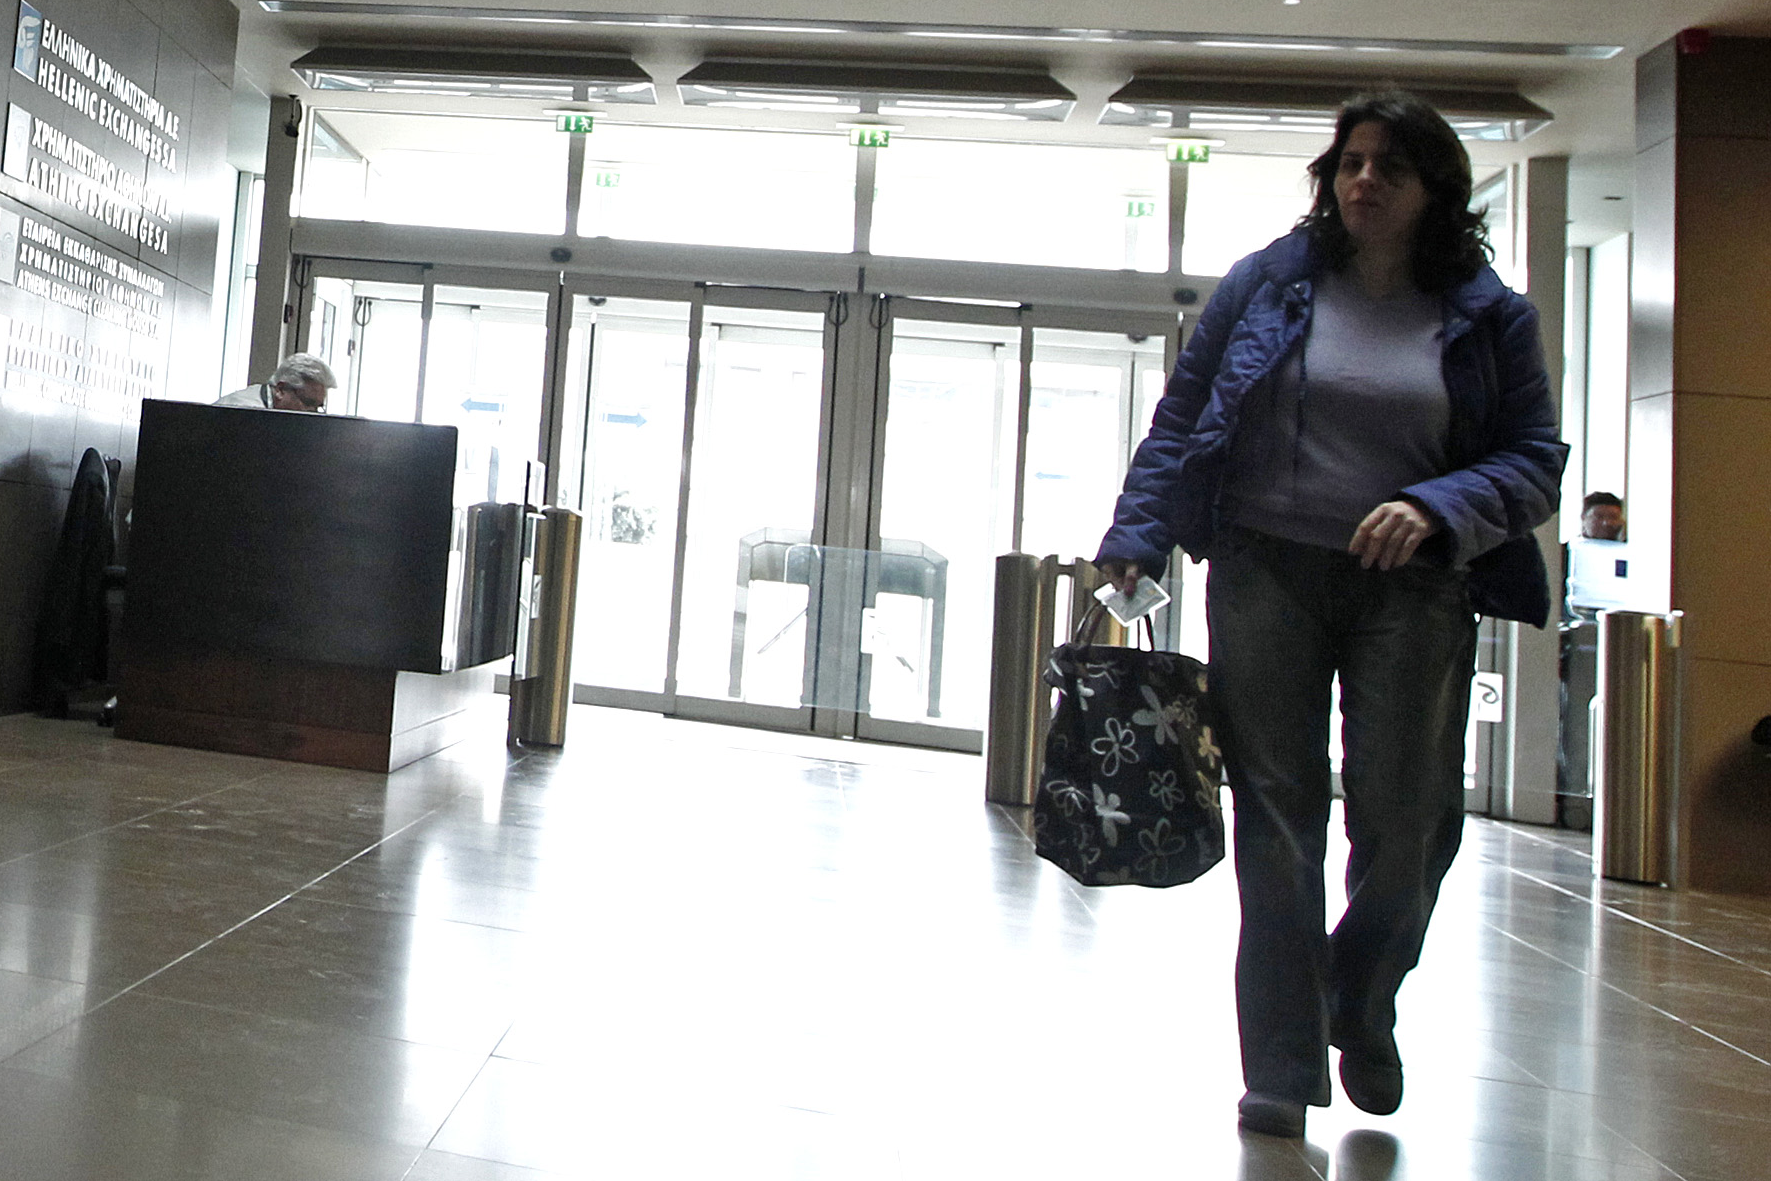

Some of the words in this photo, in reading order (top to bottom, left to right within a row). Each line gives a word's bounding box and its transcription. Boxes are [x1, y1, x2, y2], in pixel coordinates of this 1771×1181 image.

[41, 18, 96, 82] ΕΛΛΗΝΙΚΑ
[37, 57, 98, 121] HELLENIC
[98, 97, 161, 164] EXCHANGES
[21, 216, 61, 252] ΕΤΑΙΡΕΙΑ
[87, 188, 154, 248] EXCHANGE
[16, 268, 51, 300] ATHENS
[19, 242, 109, 296] ΧΡΗΜΑΤΙΣΤΗΡΙΟΥ
